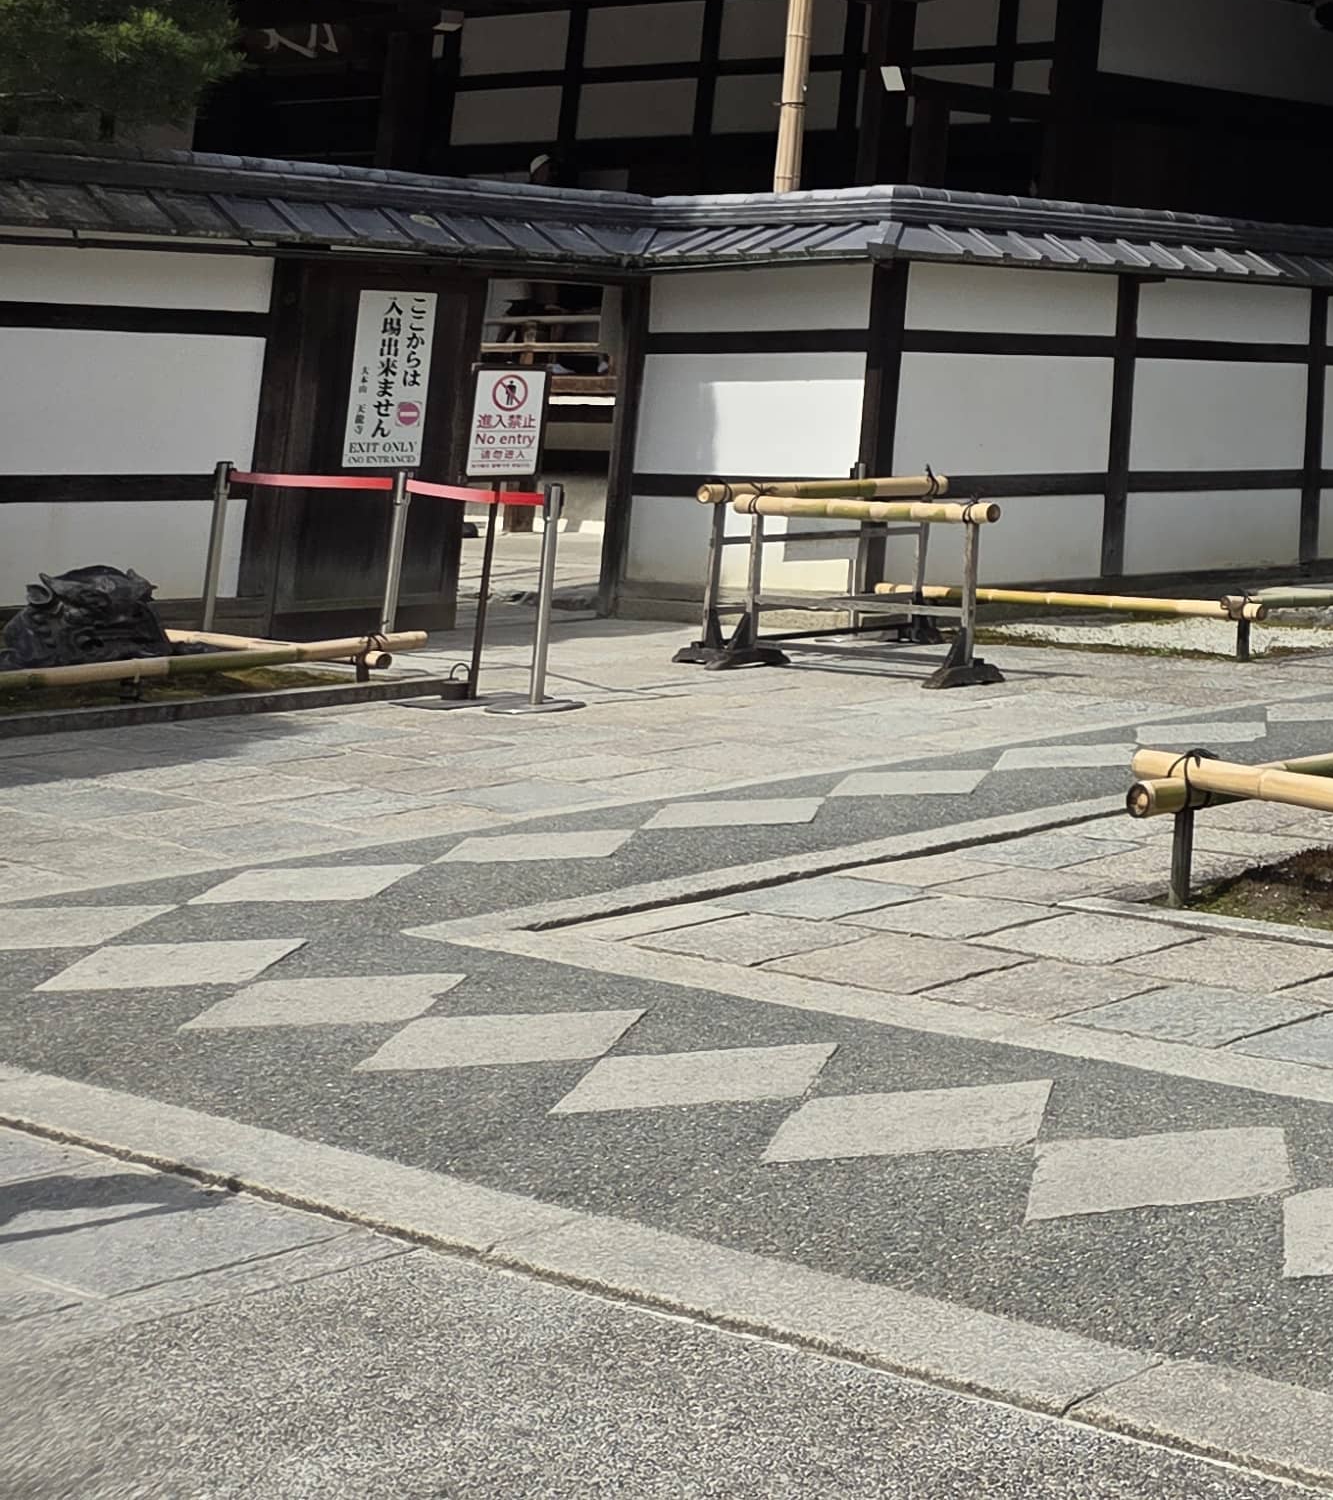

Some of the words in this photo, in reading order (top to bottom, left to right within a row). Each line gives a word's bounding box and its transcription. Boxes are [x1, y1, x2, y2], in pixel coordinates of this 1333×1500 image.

[402, 297, 427, 387] ここからは
[371, 297, 403, 438] 入場出来ません
[476, 413, 537, 429] 進入禁止
[349, 441, 380, 454] EXIT
[382, 440, 418, 453] ONLY
[475, 433, 496, 445] No
[499, 433, 536, 448] entry
